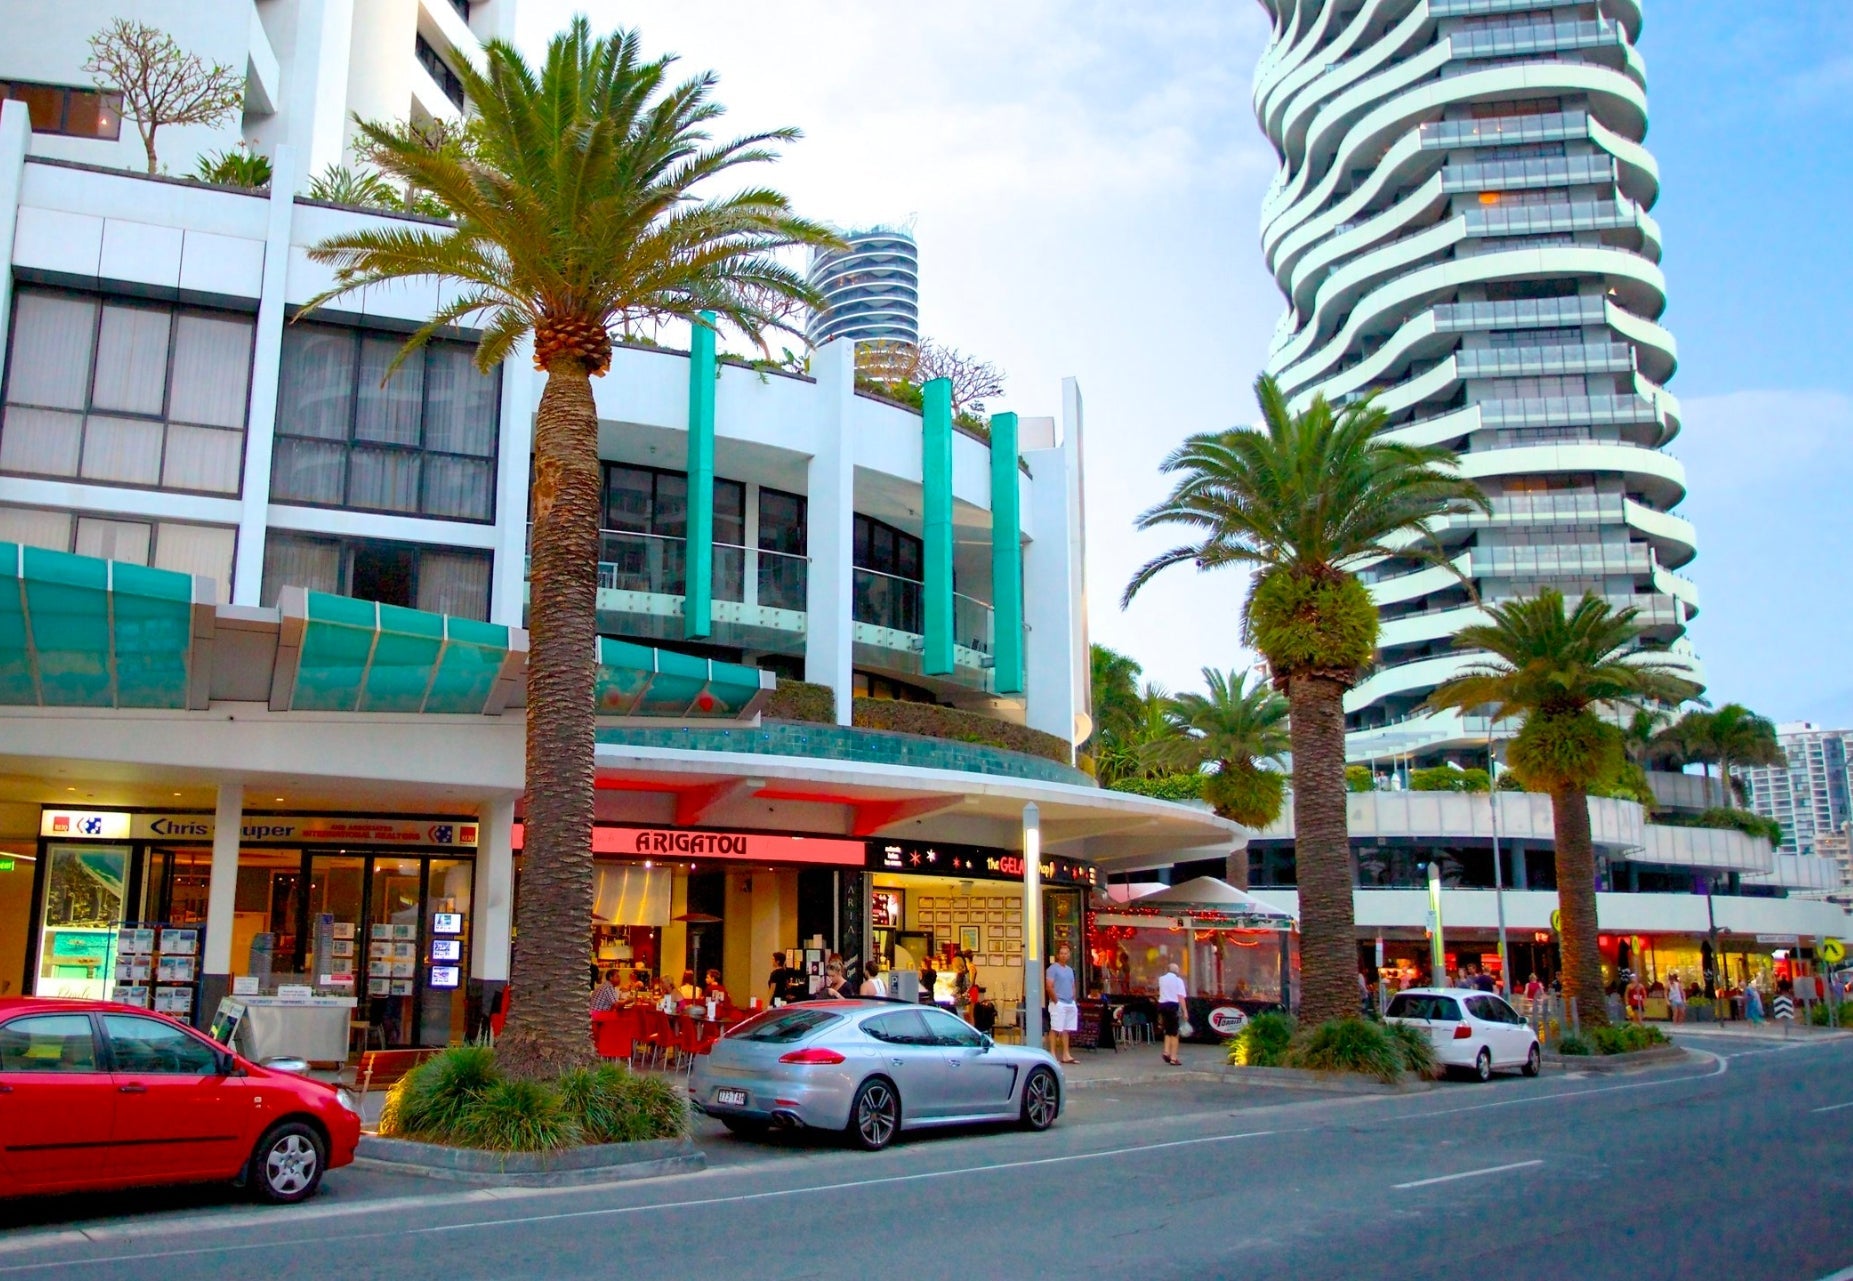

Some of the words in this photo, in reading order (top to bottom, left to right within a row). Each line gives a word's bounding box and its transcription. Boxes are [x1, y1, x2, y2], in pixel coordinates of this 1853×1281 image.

[150, 818, 208, 835] Chris
[213, 825, 295, 839] uper
[636, 832, 747, 854] ARIGATOU
[987, 857, 1000, 870] the
[1000, 856, 1025, 875] GELA
[1038, 861, 1050, 878] hop
